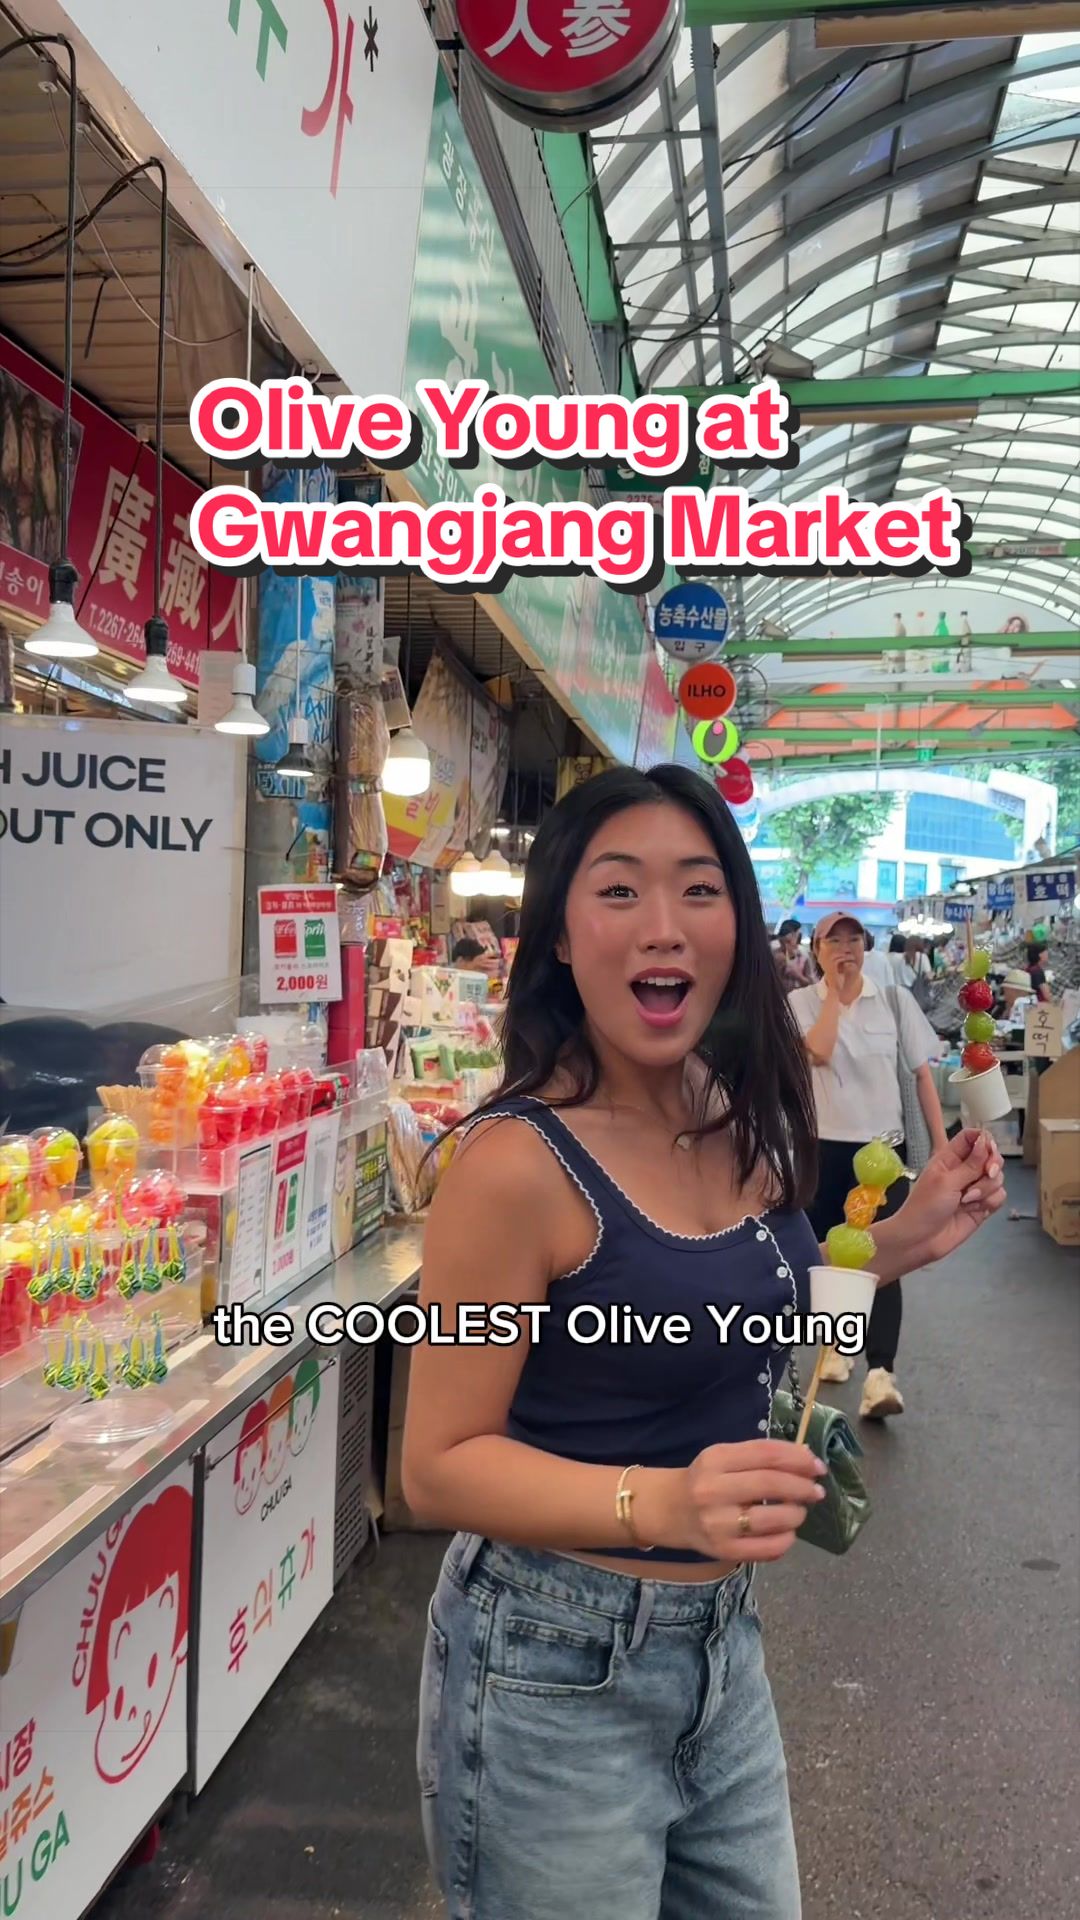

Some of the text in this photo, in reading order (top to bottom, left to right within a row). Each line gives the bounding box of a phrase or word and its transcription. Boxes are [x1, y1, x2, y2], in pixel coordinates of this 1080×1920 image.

[660, 603, 727, 631] 농축수산물
[688, 684, 726, 698] ILHO
[22, 751, 166, 793] JUICE
[0, 806, 214, 852] UT ONLY
[276, 965, 328, 992] 2,000원
[1031, 1009, 1055, 1055] 호떡
[72, 1551, 108, 1688] CHUU
[31, 1810, 70, 1882] GA
